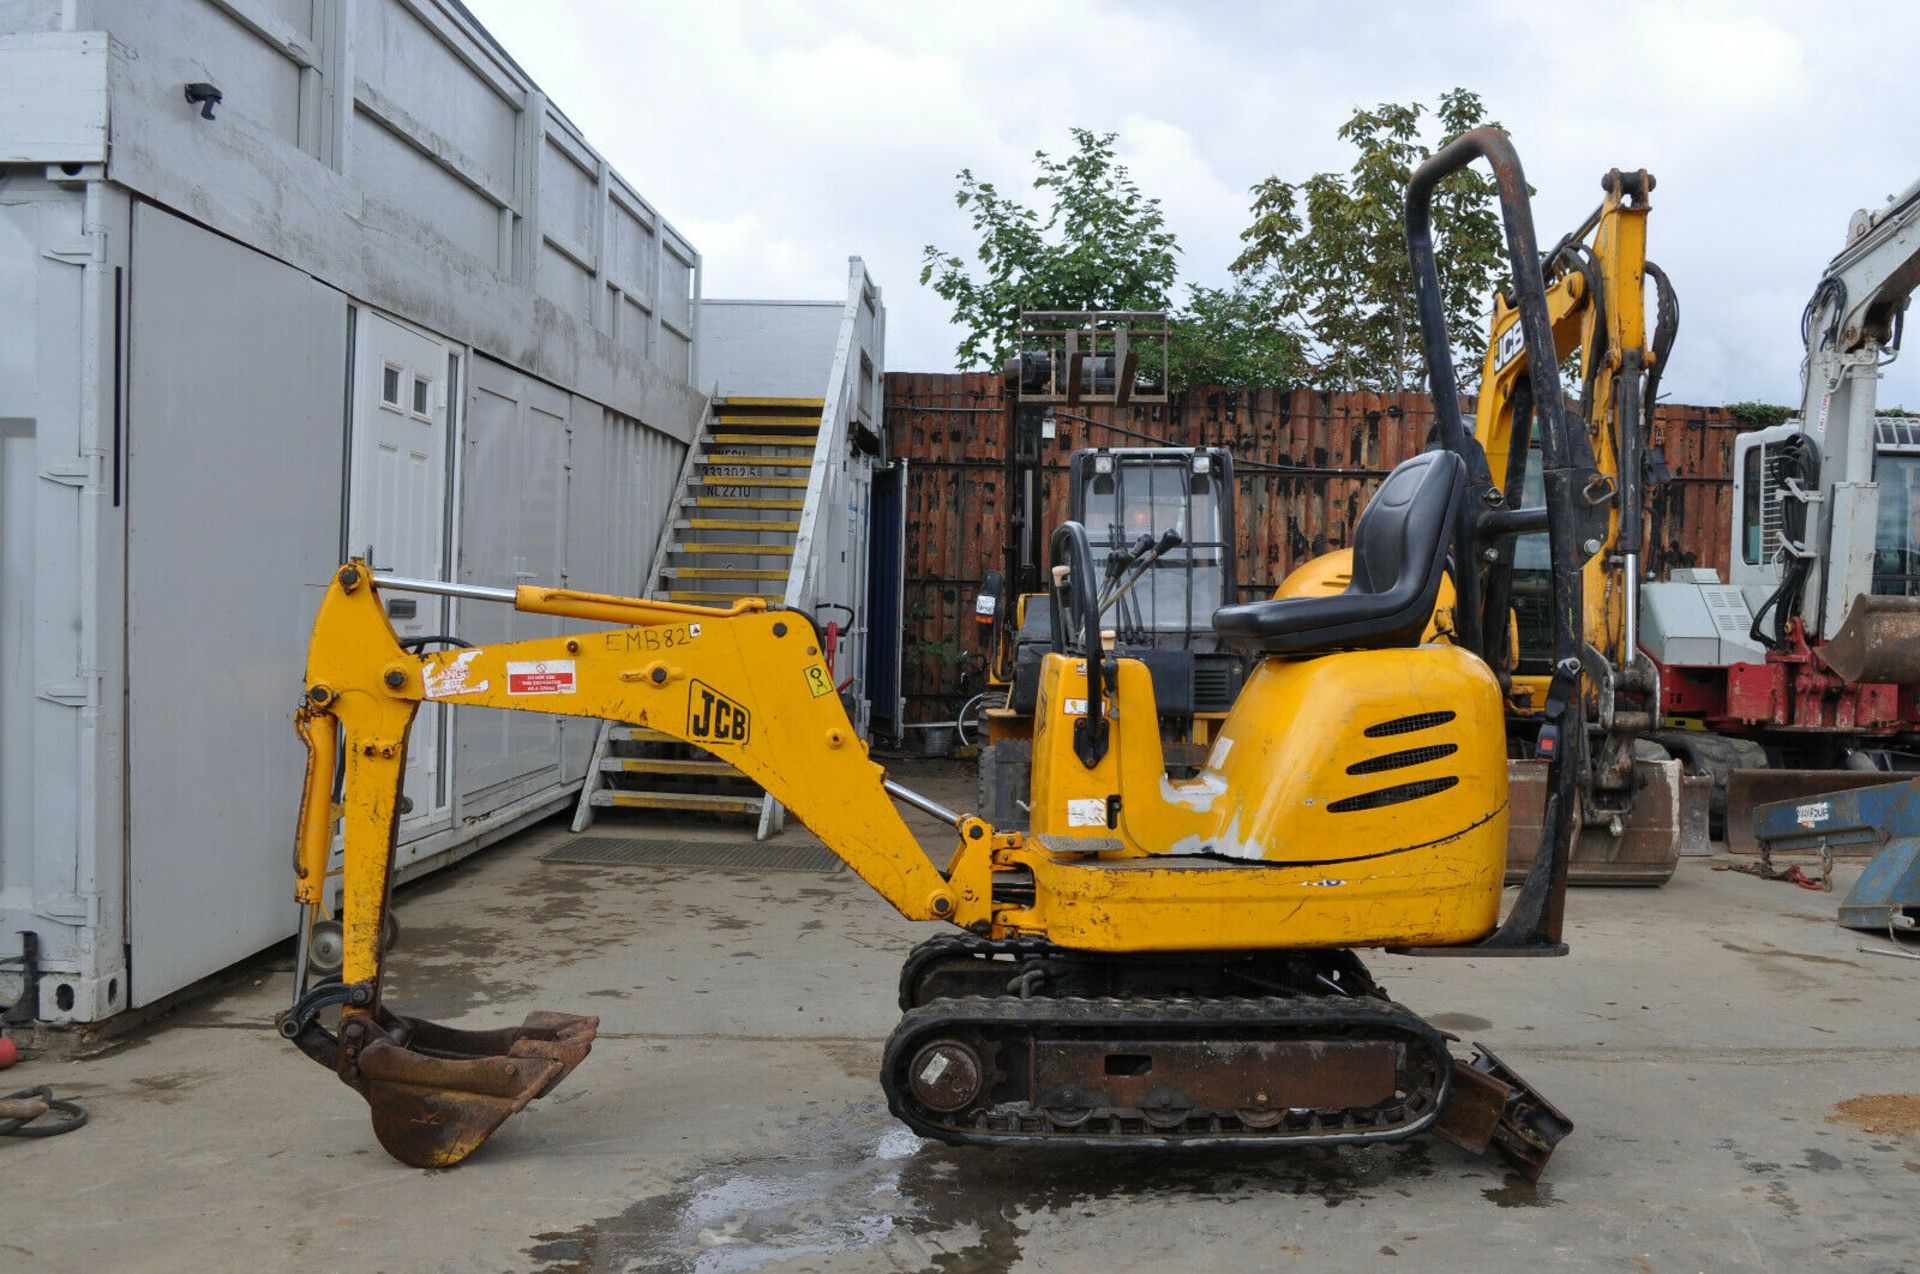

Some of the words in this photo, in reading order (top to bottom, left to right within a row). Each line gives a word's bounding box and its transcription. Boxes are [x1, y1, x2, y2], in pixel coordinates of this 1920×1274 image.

[1494, 319, 1525, 372] JCB
[606, 627, 691, 652] EMB82
[693, 689, 746, 740] JCB
